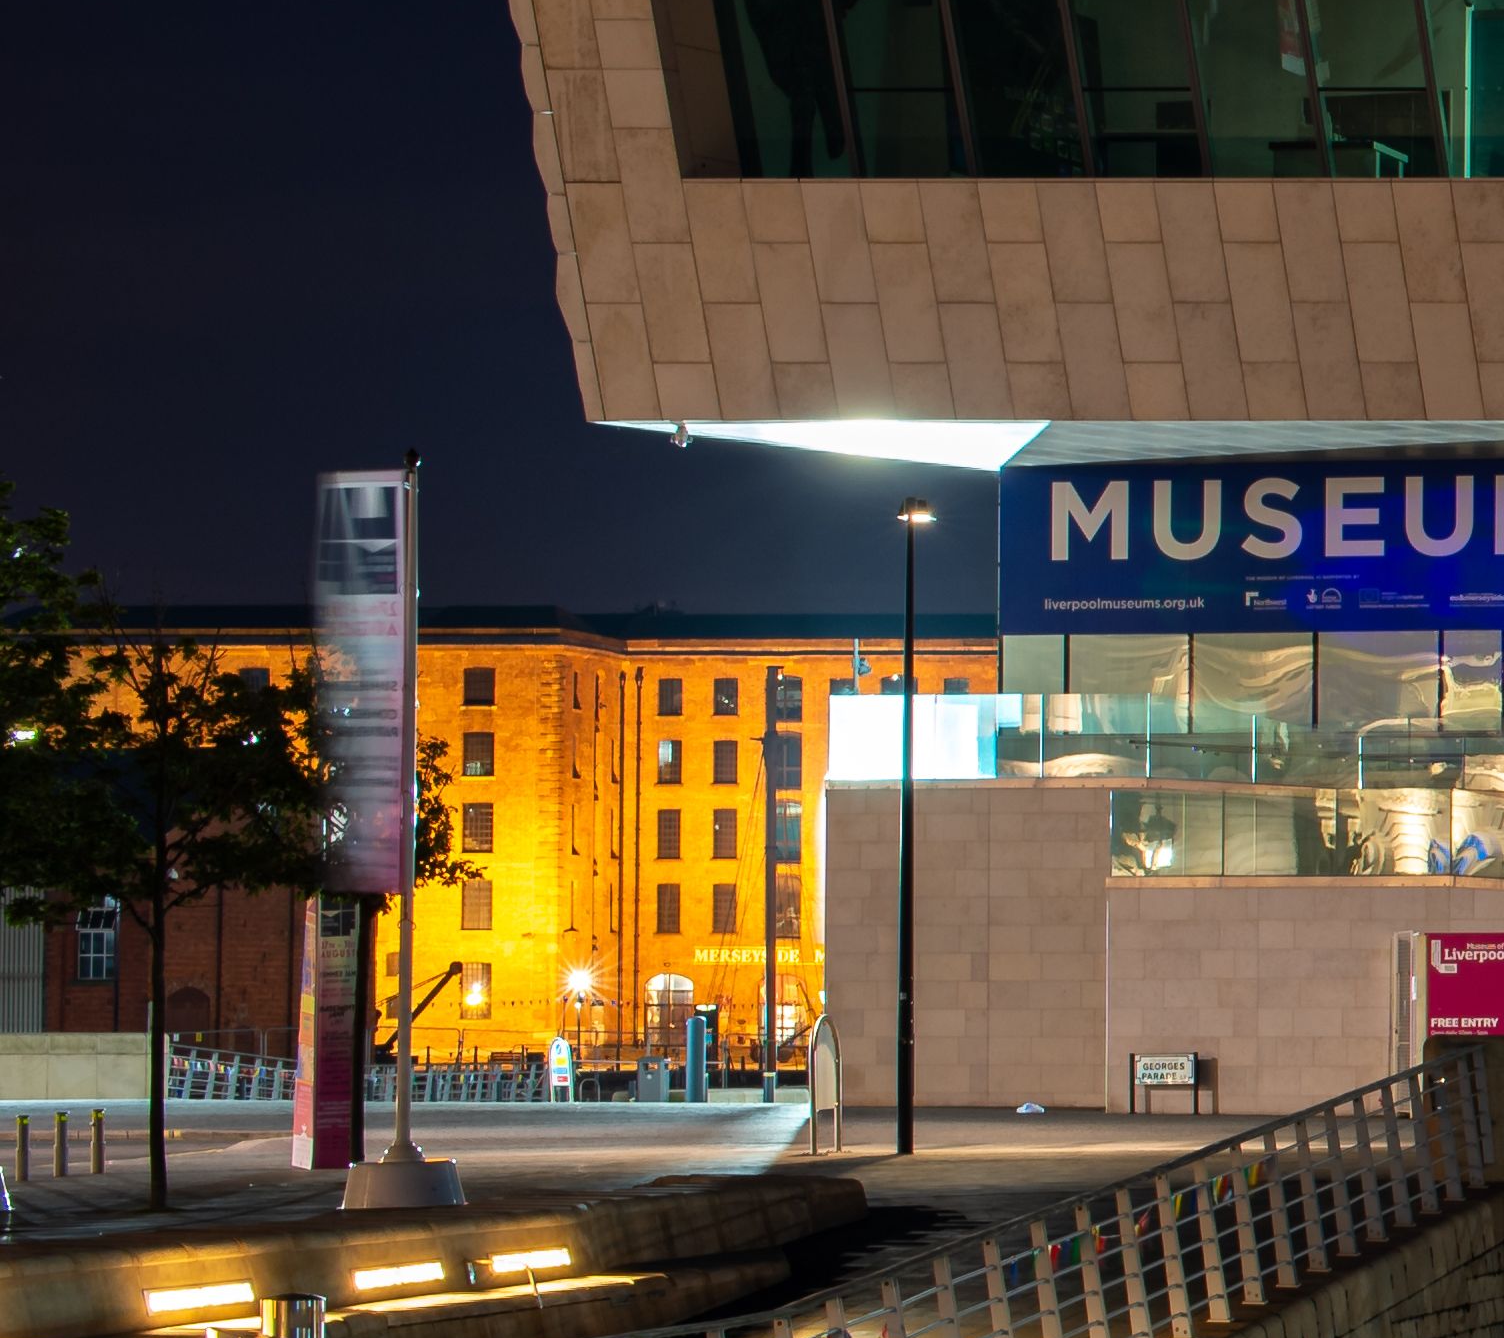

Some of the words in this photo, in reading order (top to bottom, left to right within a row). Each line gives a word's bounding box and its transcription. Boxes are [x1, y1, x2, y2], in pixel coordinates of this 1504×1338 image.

[1044, 596, 1205, 612] liverpoolmuseums.org.uk
[1466, 942, 1496, 950] Museum
[1496, 942, 1504, 950] of
[694, 948, 800, 963] MERSEYSDE
[1430, 1017, 1459, 1028] FREE
[1461, 1017, 1499, 1028] ENTRY
[1142, 1062, 1185, 1071] GEORGES
[1141, 1072, 1177, 1080] PARADE
